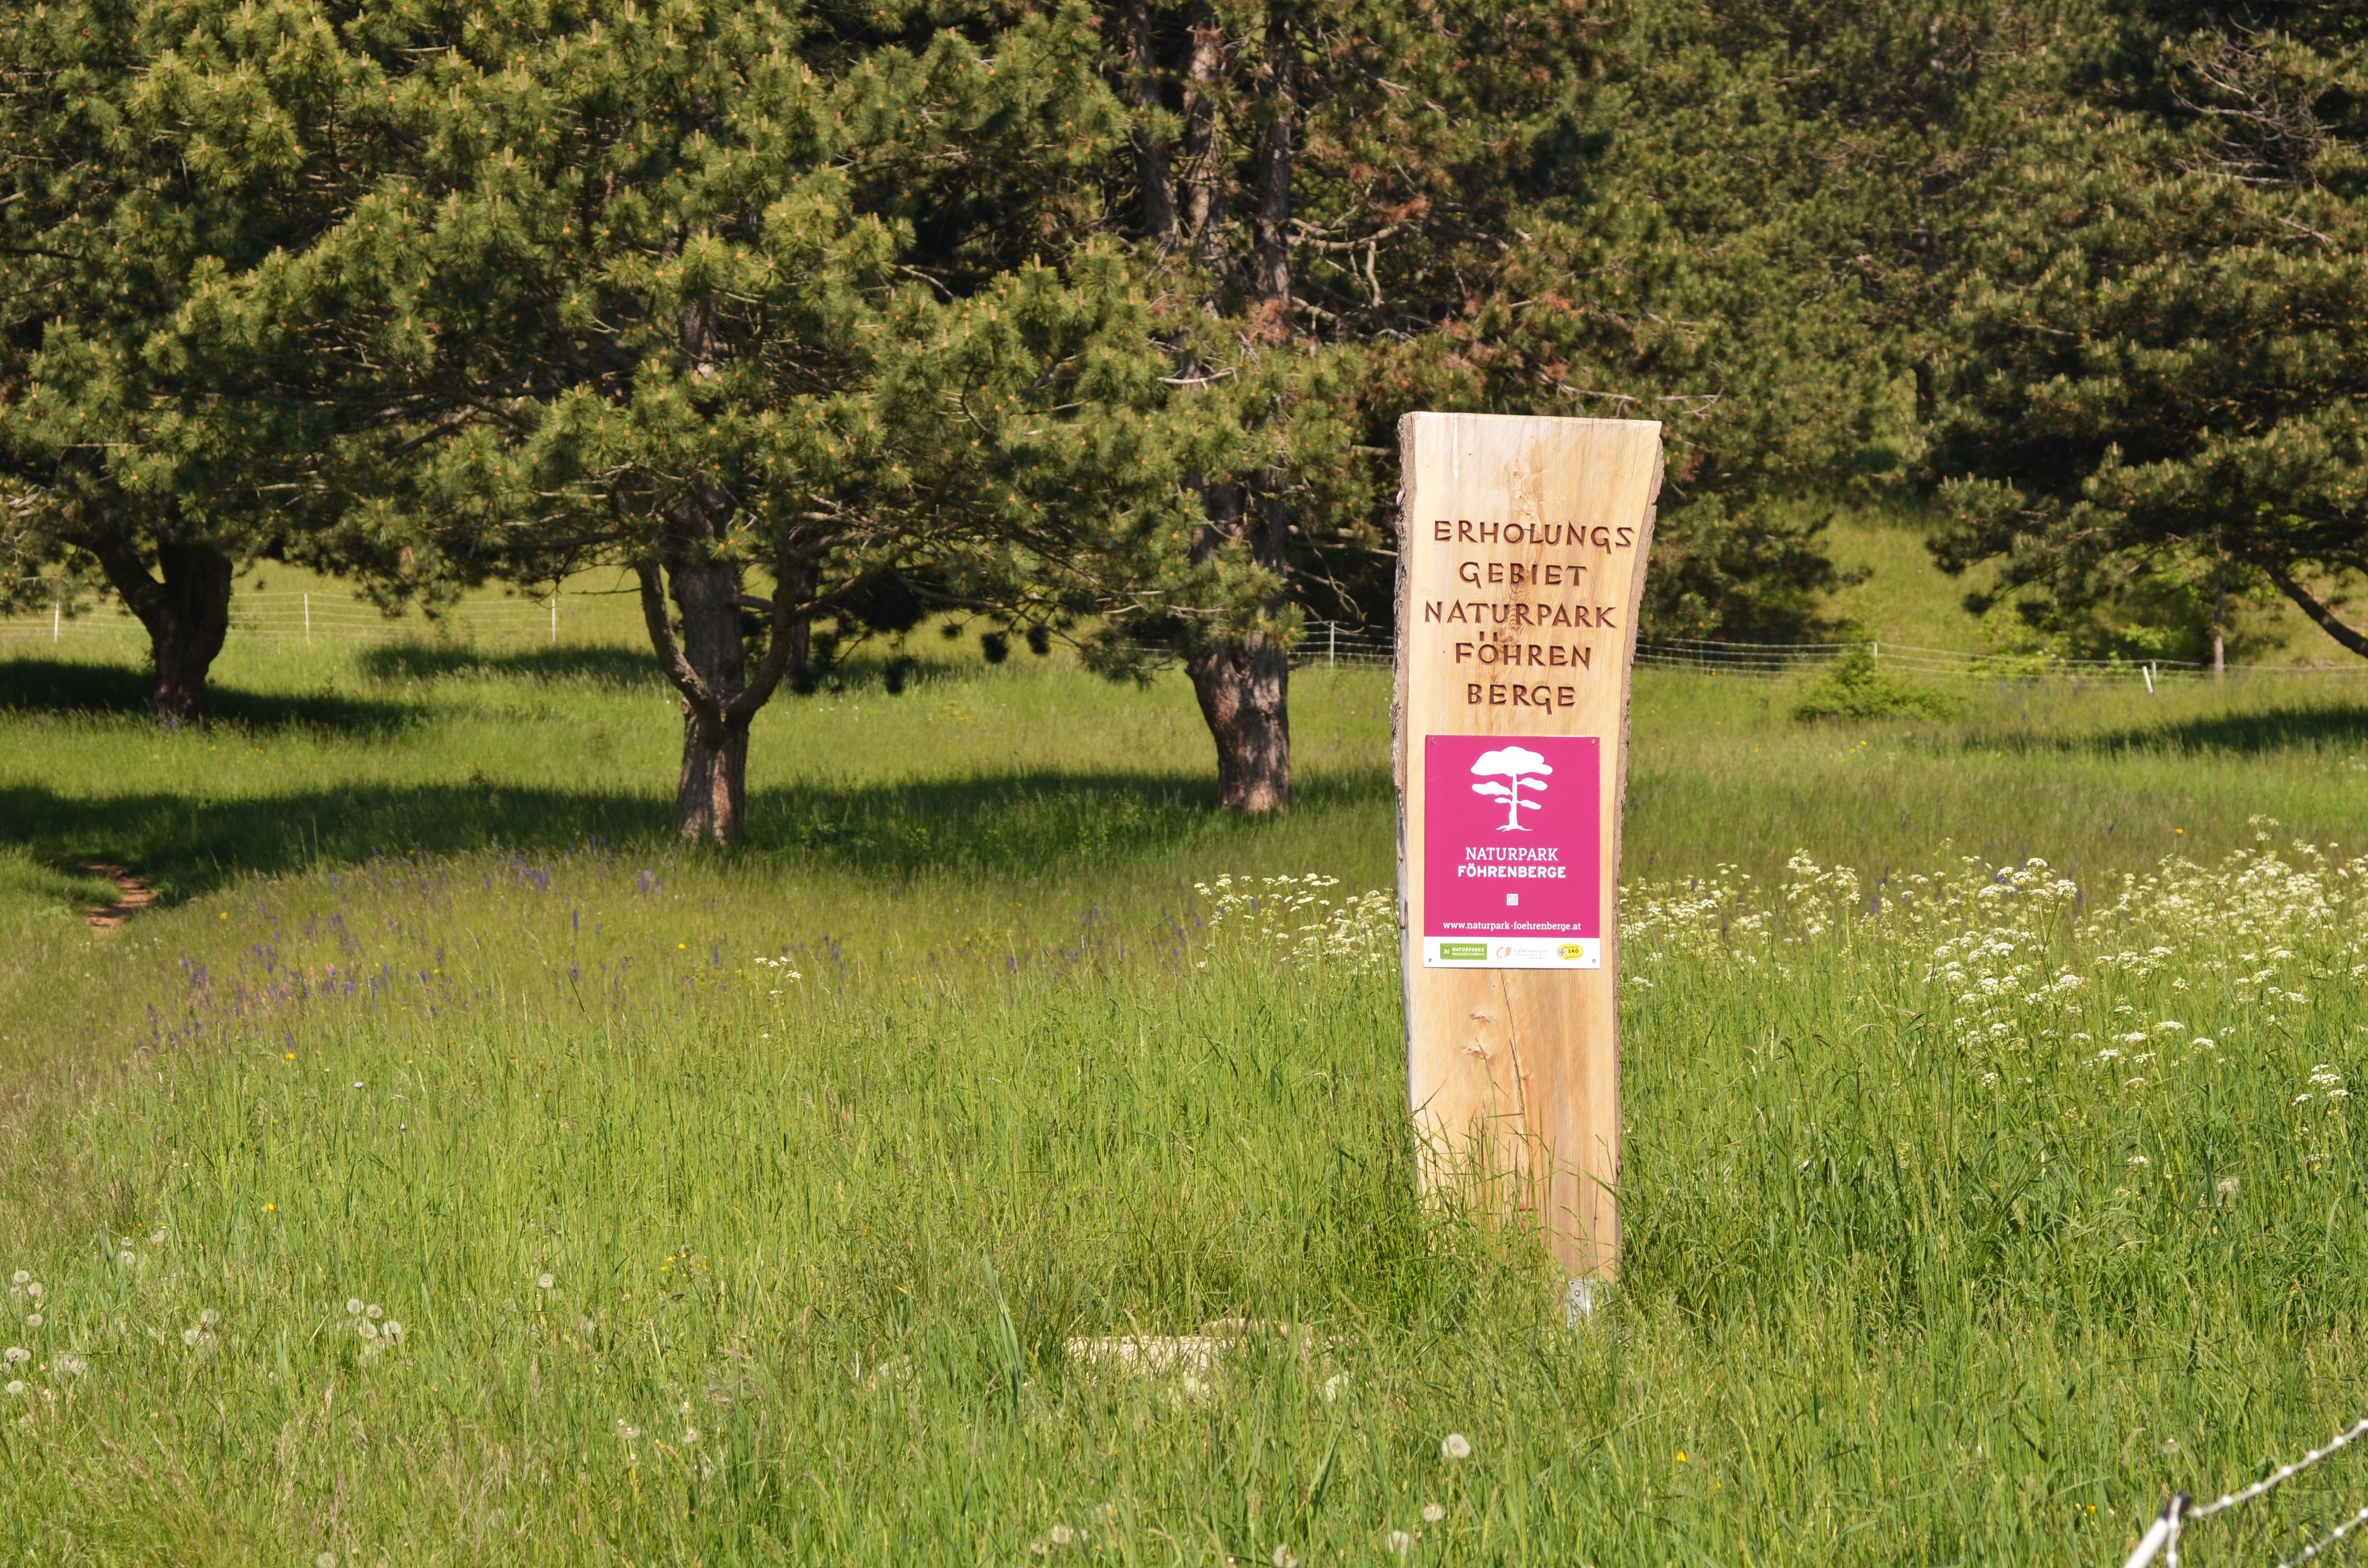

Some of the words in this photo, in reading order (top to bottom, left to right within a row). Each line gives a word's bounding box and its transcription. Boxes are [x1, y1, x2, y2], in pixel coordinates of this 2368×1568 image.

[1434, 520, 1634, 554] ERHOLUNGS
[1460, 562, 1588, 589] GEBIET
[1425, 599, 1616, 628] NATURPARK
[1455, 631, 1591, 671] FÖHREN
[1468, 684, 1576, 714] BERGE
[1466, 847, 1558, 861] NATURPARK
[1457, 863, 1566, 878] FÖHRENBERGE
[1443, 921, 1581, 931] www.naturpark-foehrenberge.at
